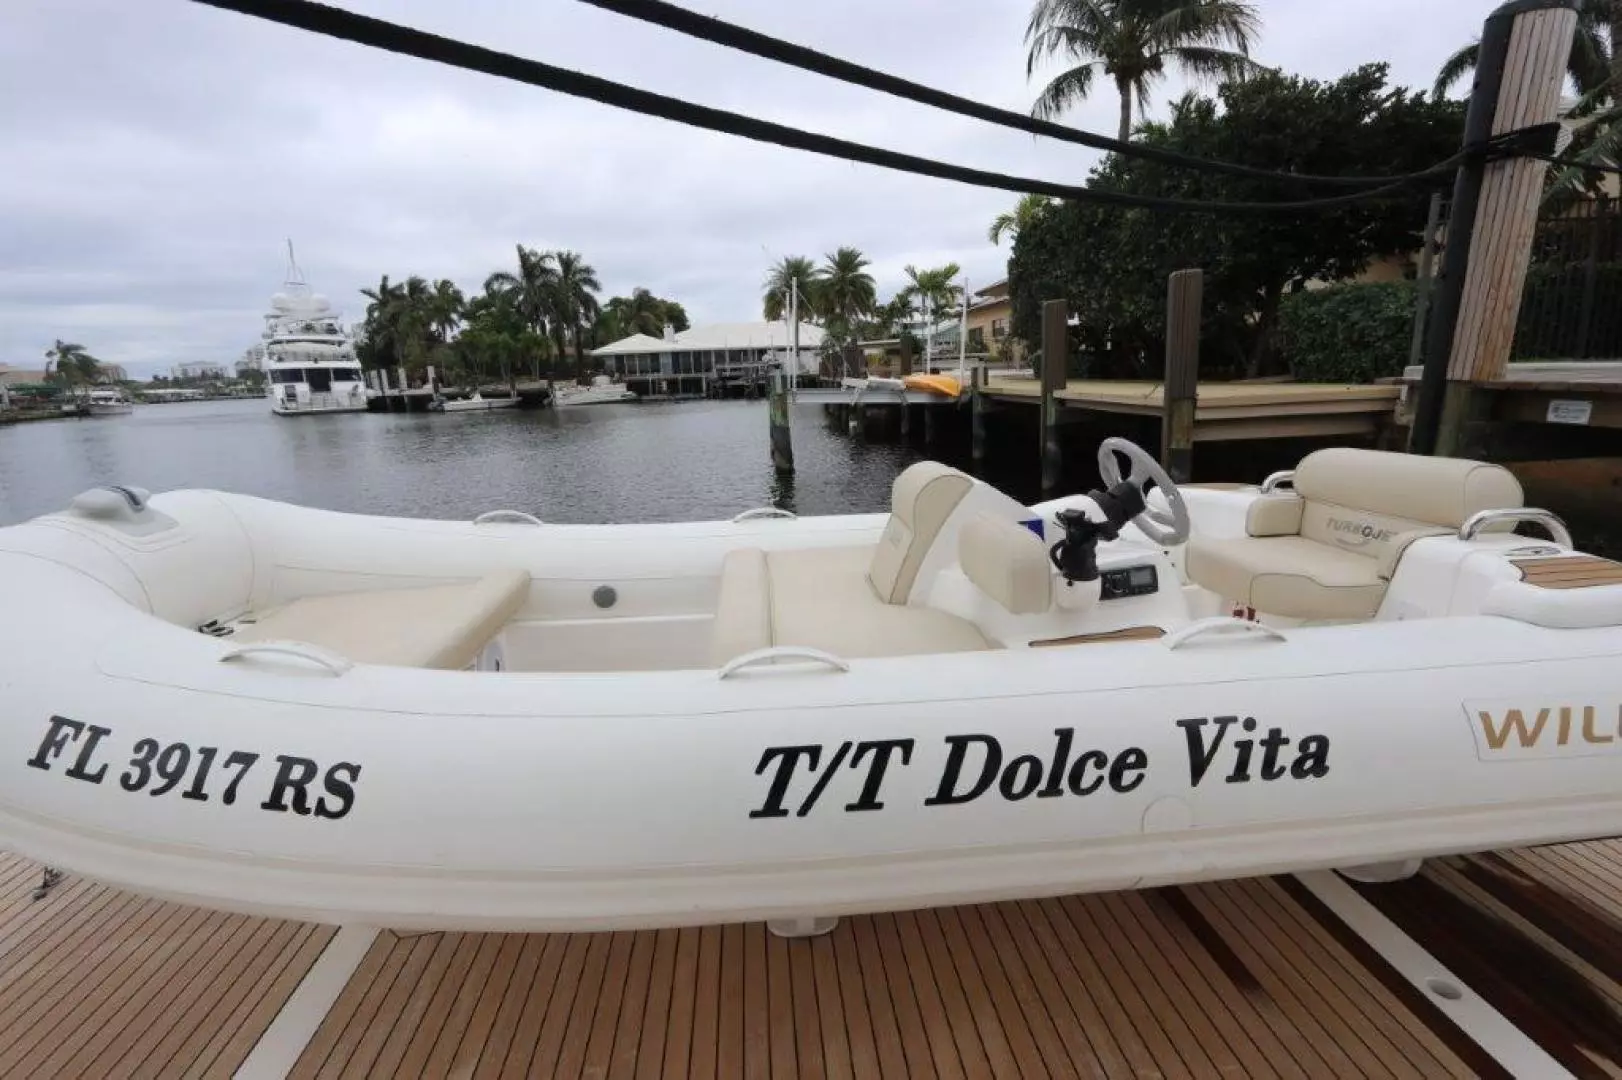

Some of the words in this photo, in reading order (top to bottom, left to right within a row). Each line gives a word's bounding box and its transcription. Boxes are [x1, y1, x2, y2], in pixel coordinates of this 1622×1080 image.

[27, 715, 111, 784] FL
[120, 738, 259, 805] 3917
[261, 755, 361, 819] RS
[749, 738, 914, 819] T/T
[924, 727, 1148, 807] Dolce
[1176, 716, 1330, 787] Vita
[1479, 704, 1622, 749] WIL
